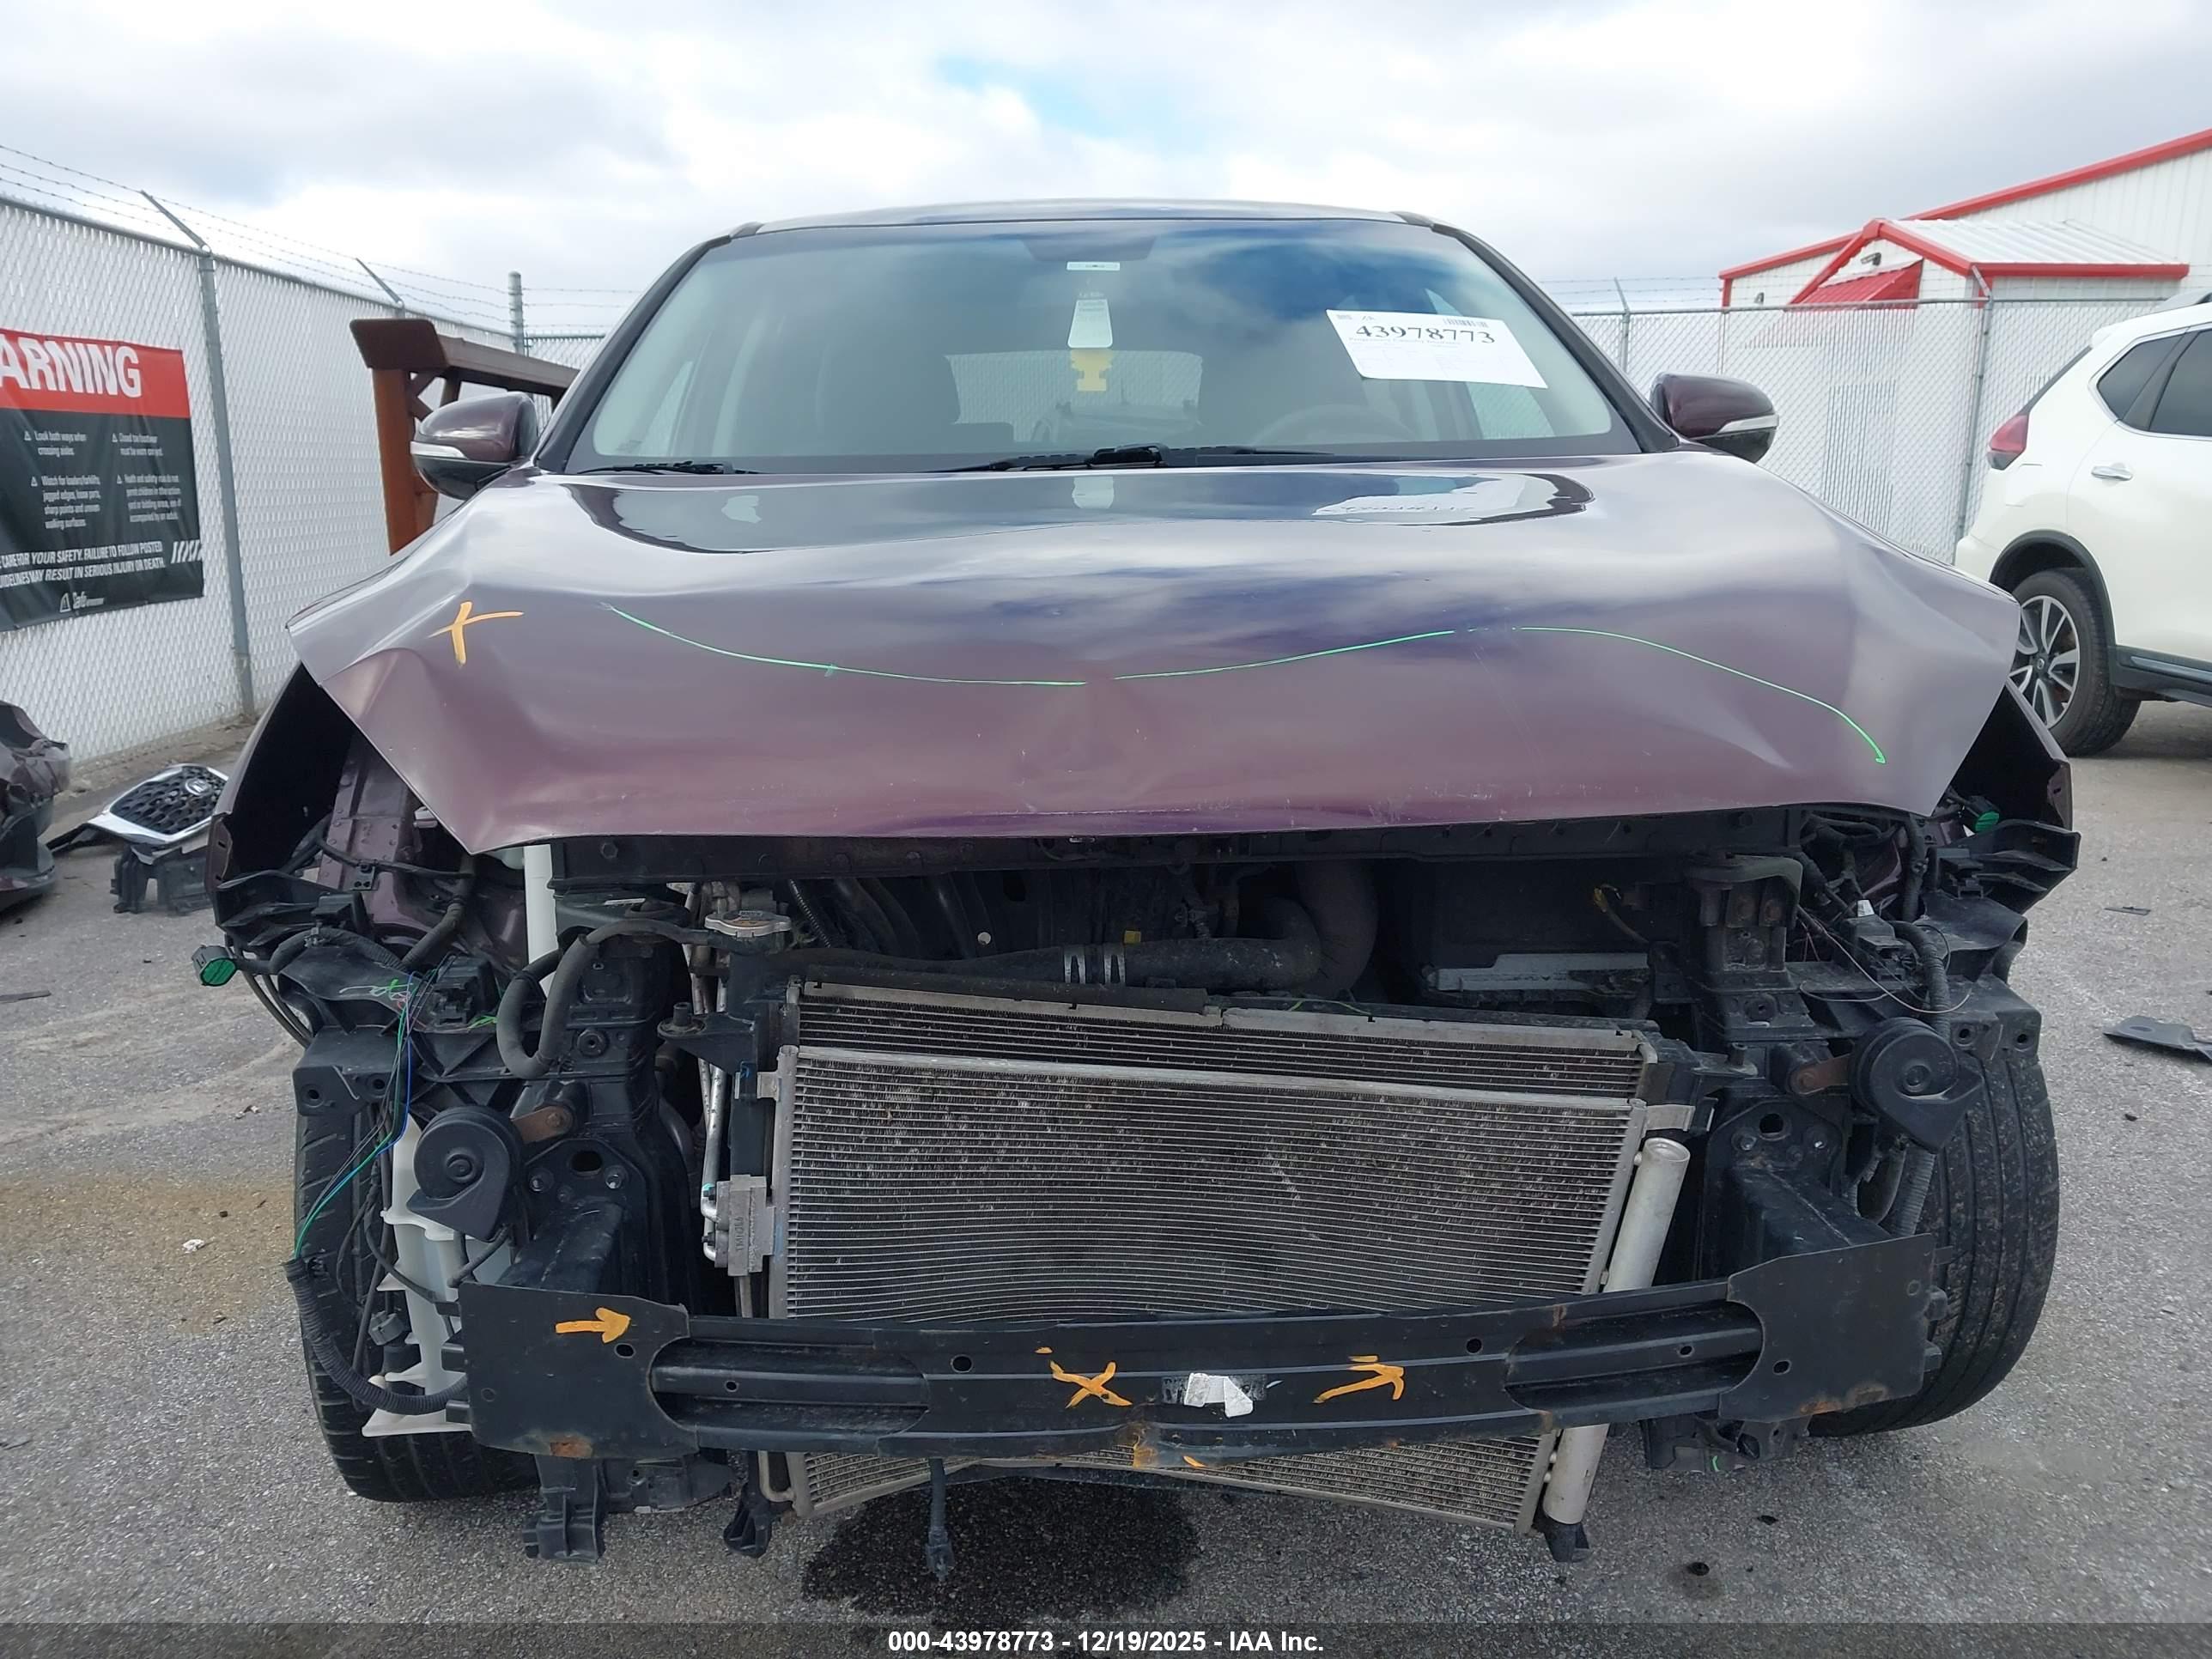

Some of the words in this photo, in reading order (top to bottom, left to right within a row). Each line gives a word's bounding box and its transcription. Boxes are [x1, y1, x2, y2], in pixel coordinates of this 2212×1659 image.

[1356, 325, 1496, 343] 43978773
[31, 551, 56, 564] YOUR
[57, 549, 83, 563] SAFETY.
[109, 545, 118, 557] TO
[140, 541, 163, 554] POSTED
[45, 567, 74, 581] RESULT
[74, 566, 83, 579] IN
[84, 563, 112, 578] SERIOUS
